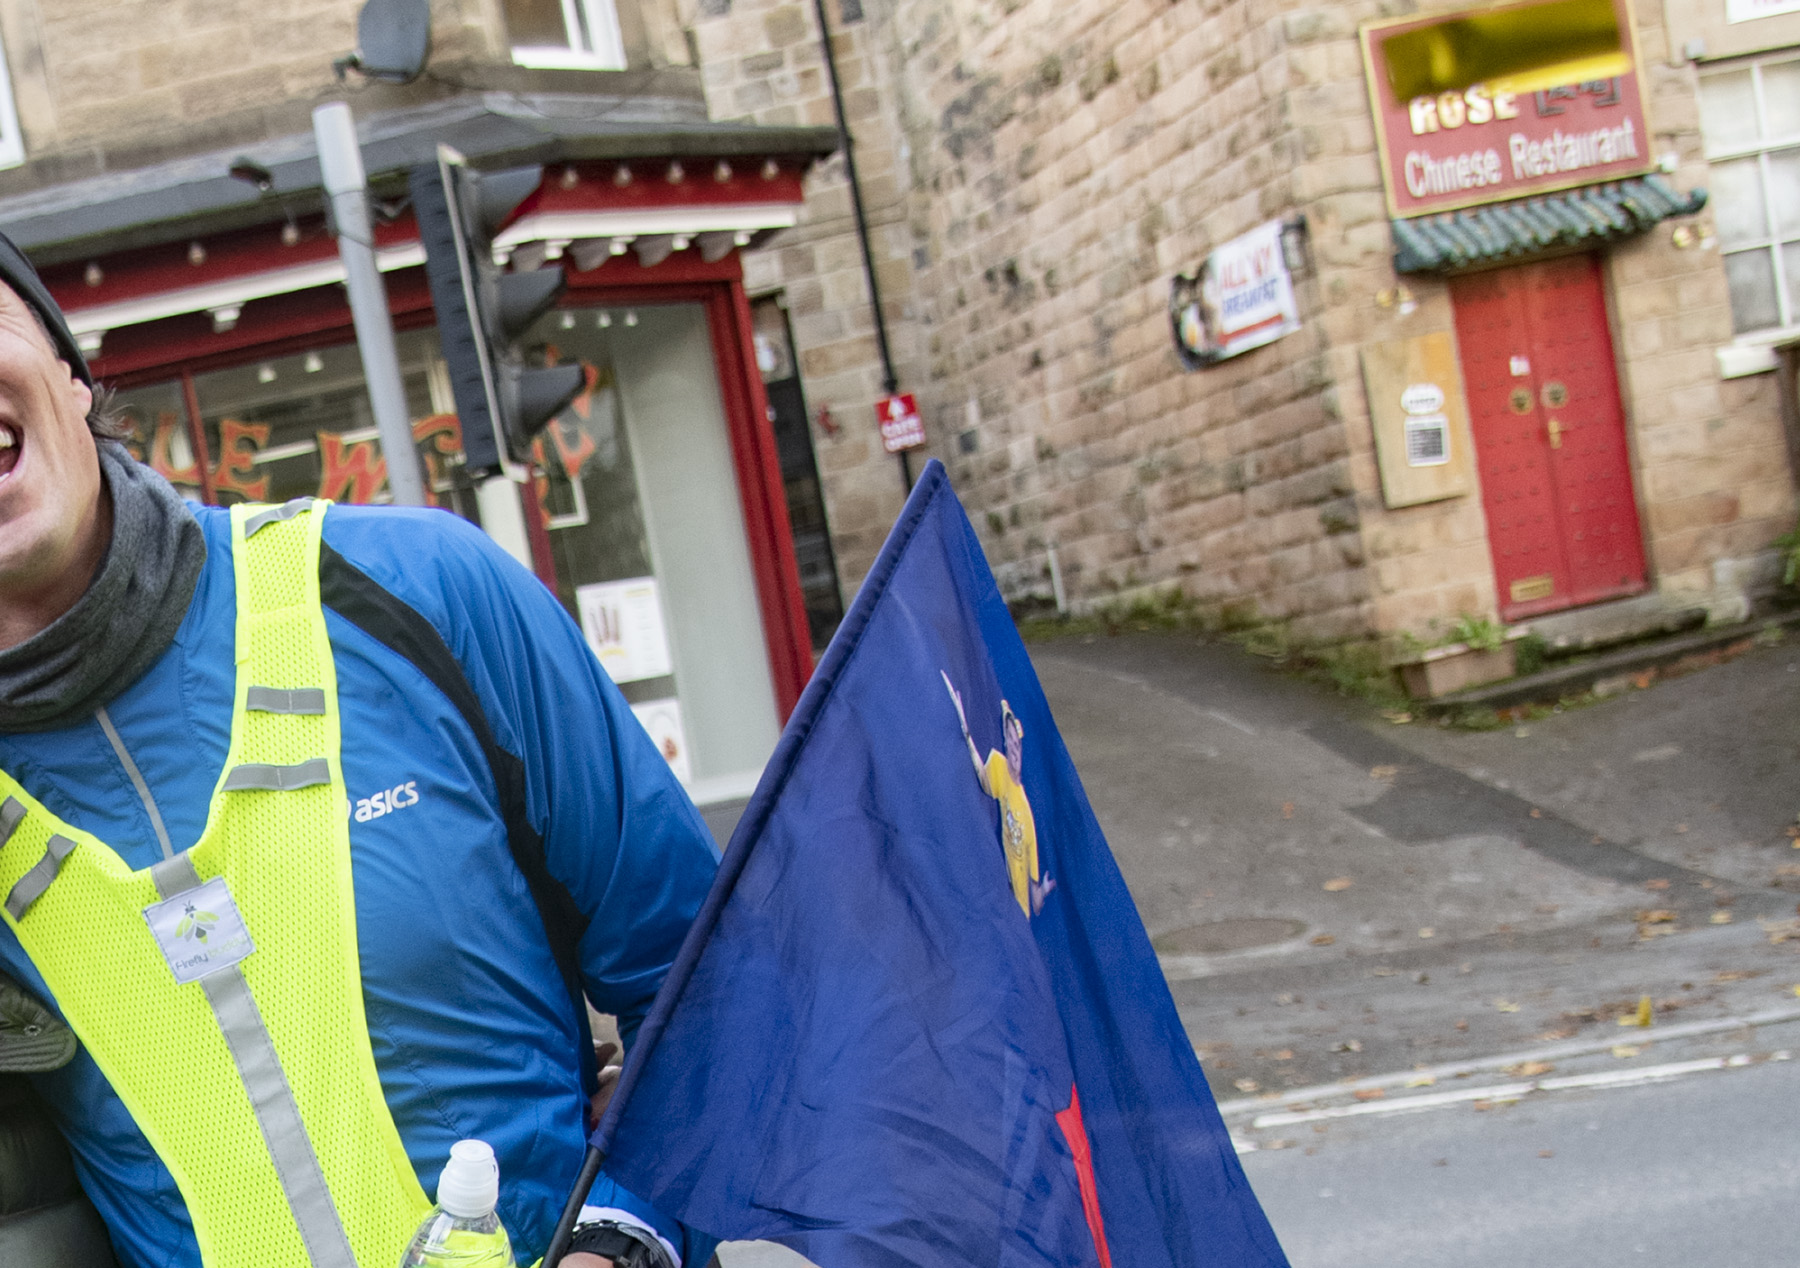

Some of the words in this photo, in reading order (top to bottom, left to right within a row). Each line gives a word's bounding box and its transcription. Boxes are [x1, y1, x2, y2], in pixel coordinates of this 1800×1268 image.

[1404, 148, 1501, 198] Chinese
[1509, 116, 1638, 180] Restaurant
[354, 781, 419, 823] asics
